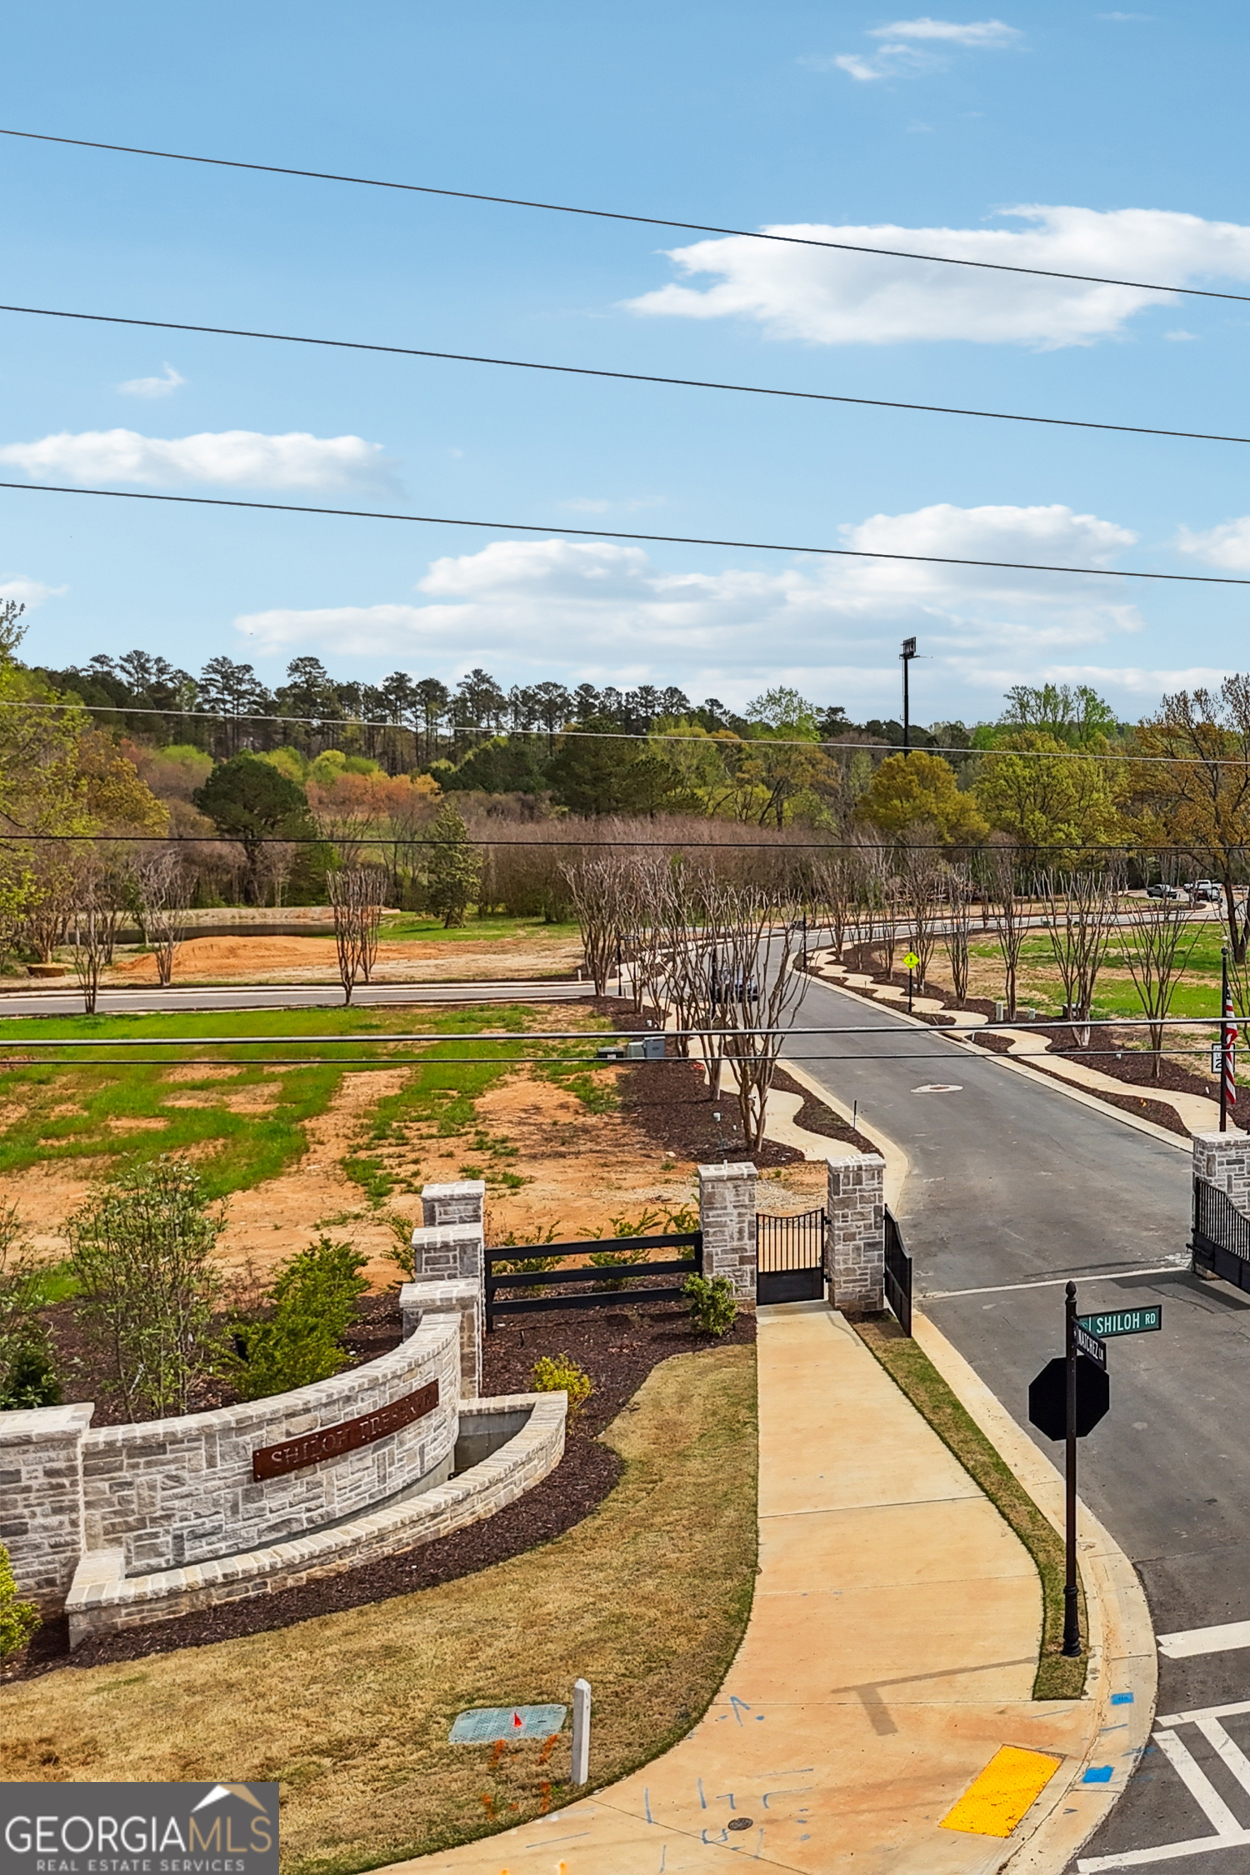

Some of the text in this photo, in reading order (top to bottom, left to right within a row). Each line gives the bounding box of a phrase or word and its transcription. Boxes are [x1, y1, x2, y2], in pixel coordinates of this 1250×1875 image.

[1096, 1312, 1156, 1334] SHILOH RD
[1078, 1328, 1099, 1360] NATCHEZ
[270, 1427, 351, 1469] SHILOH
